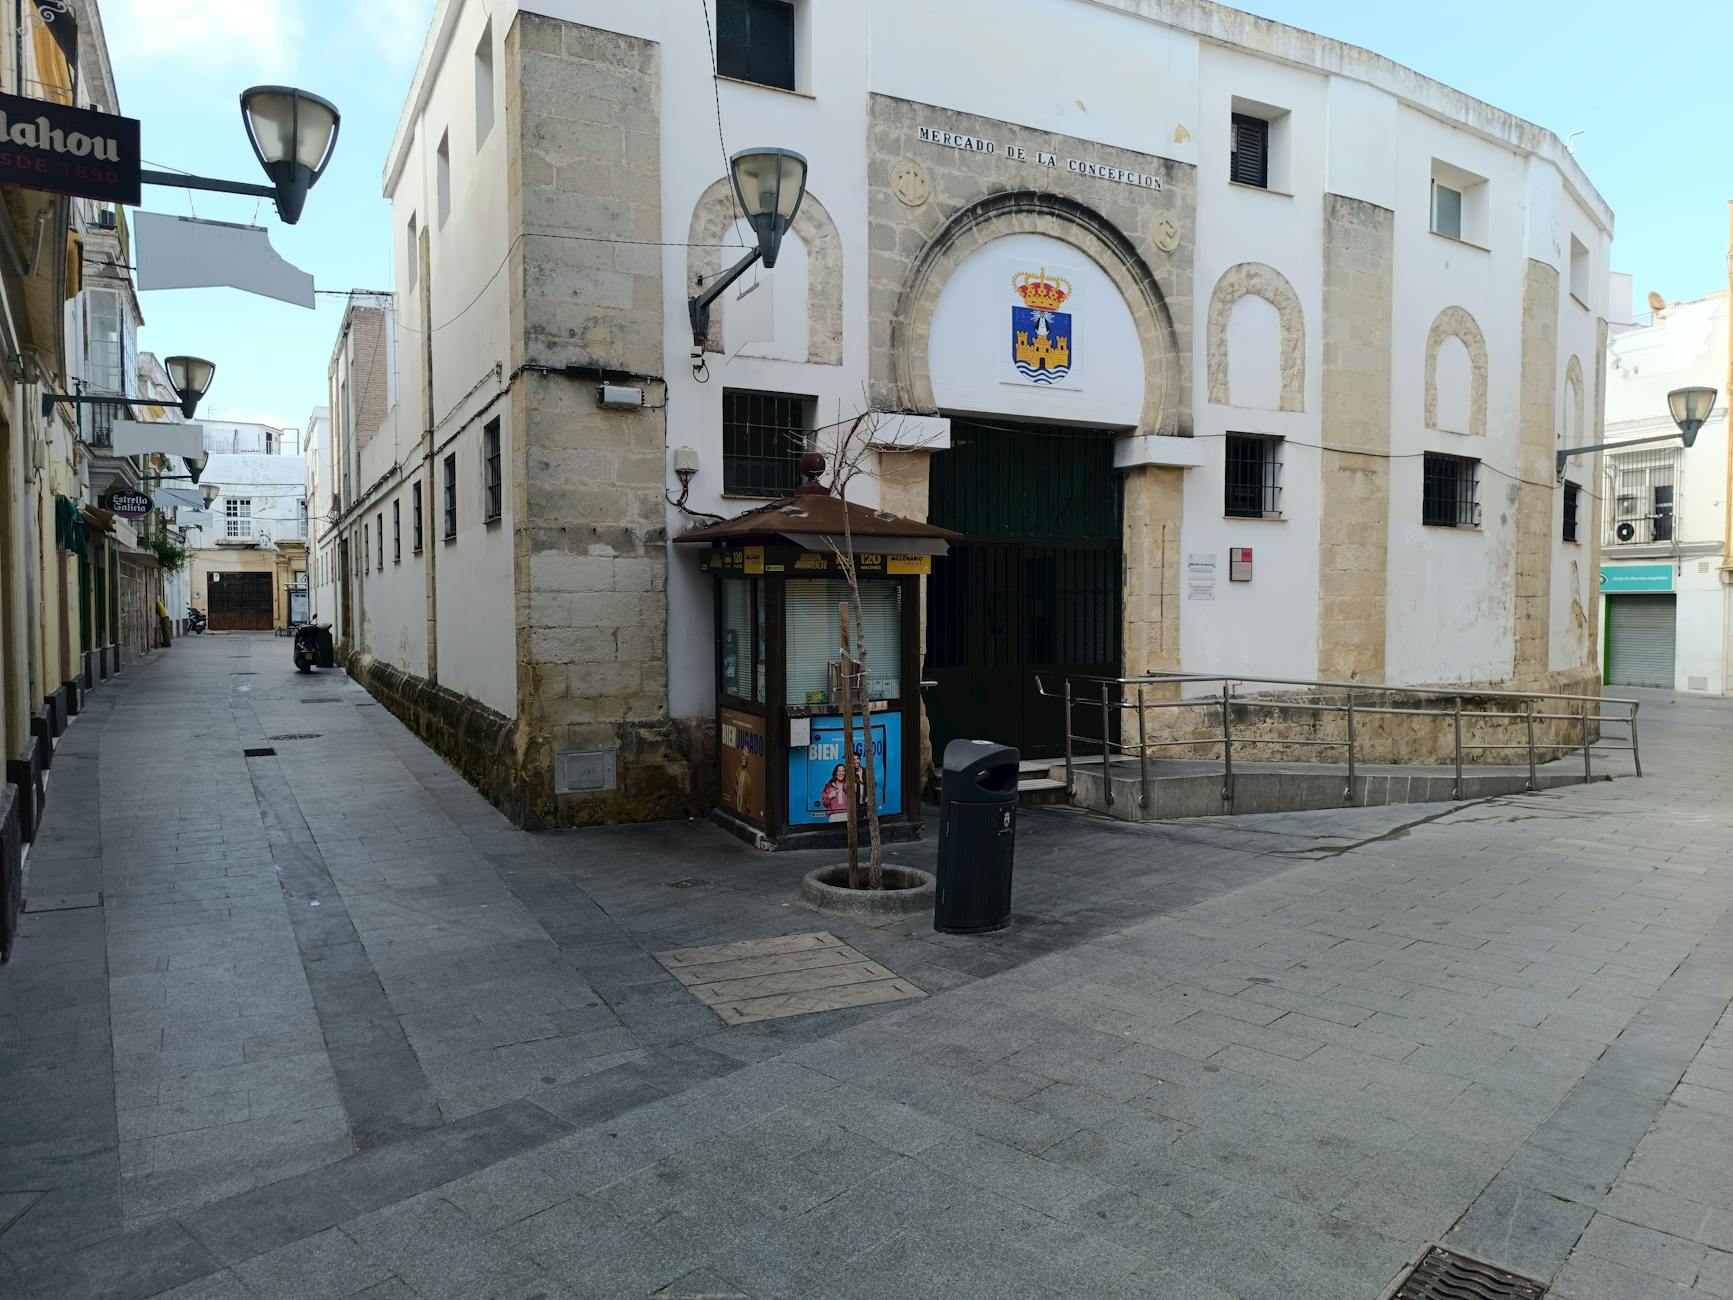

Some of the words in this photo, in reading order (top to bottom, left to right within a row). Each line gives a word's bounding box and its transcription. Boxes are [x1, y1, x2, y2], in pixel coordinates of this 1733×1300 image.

[919, 127, 995, 154] MERCADO
[1007, 146, 1026, 160] DE
[1038, 153, 1056, 167] LA
[1069, 159, 1161, 189] CONCEPCION
[63, 163, 118, 184] 1890
[112, 495, 148, 504] Estrella
[113, 503, 146, 512] Galicia
[860, 553, 881, 565] 120
[721, 723, 737, 749] BIEN
[809, 743, 839, 761] BIEN
